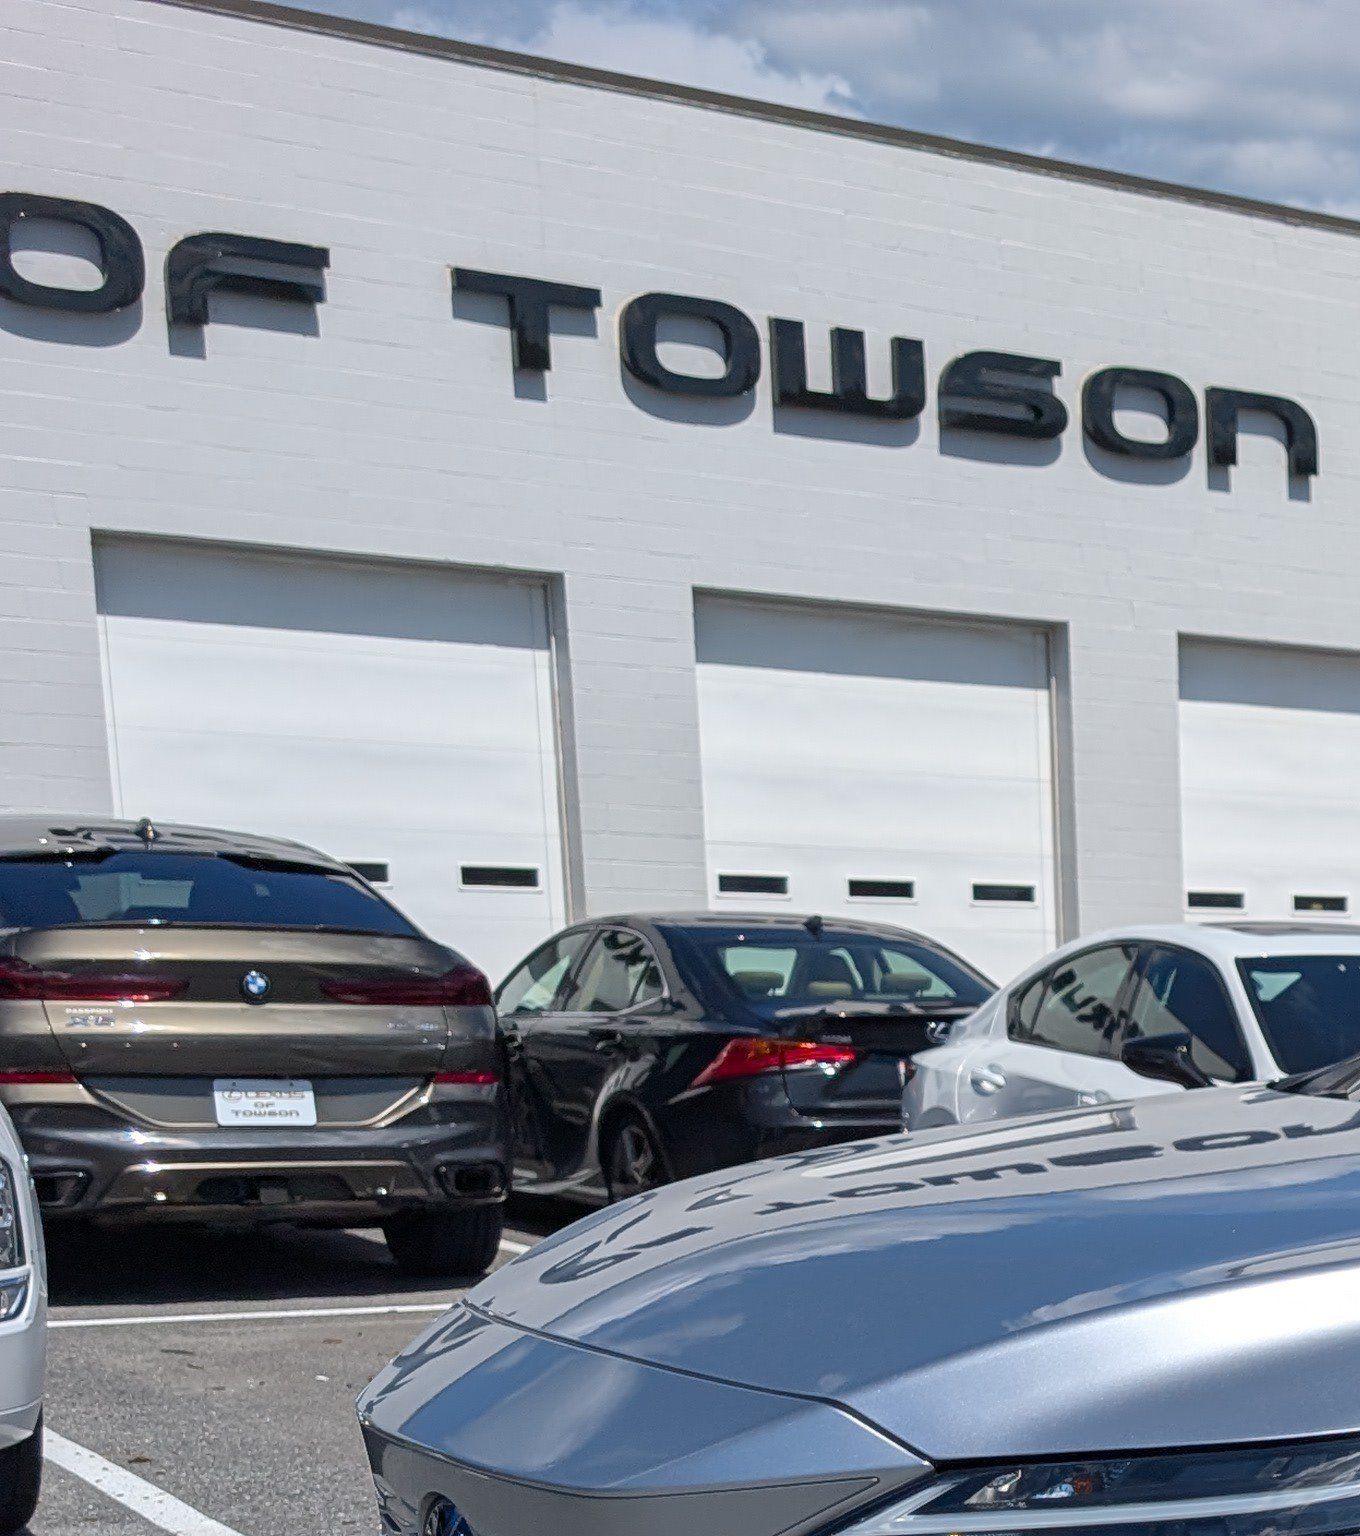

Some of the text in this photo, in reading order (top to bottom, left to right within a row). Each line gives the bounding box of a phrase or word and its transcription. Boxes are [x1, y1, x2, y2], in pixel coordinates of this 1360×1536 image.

[0, 191, 1321, 478] OF TOWSON
[230, 1109, 300, 1118] TOWSON
